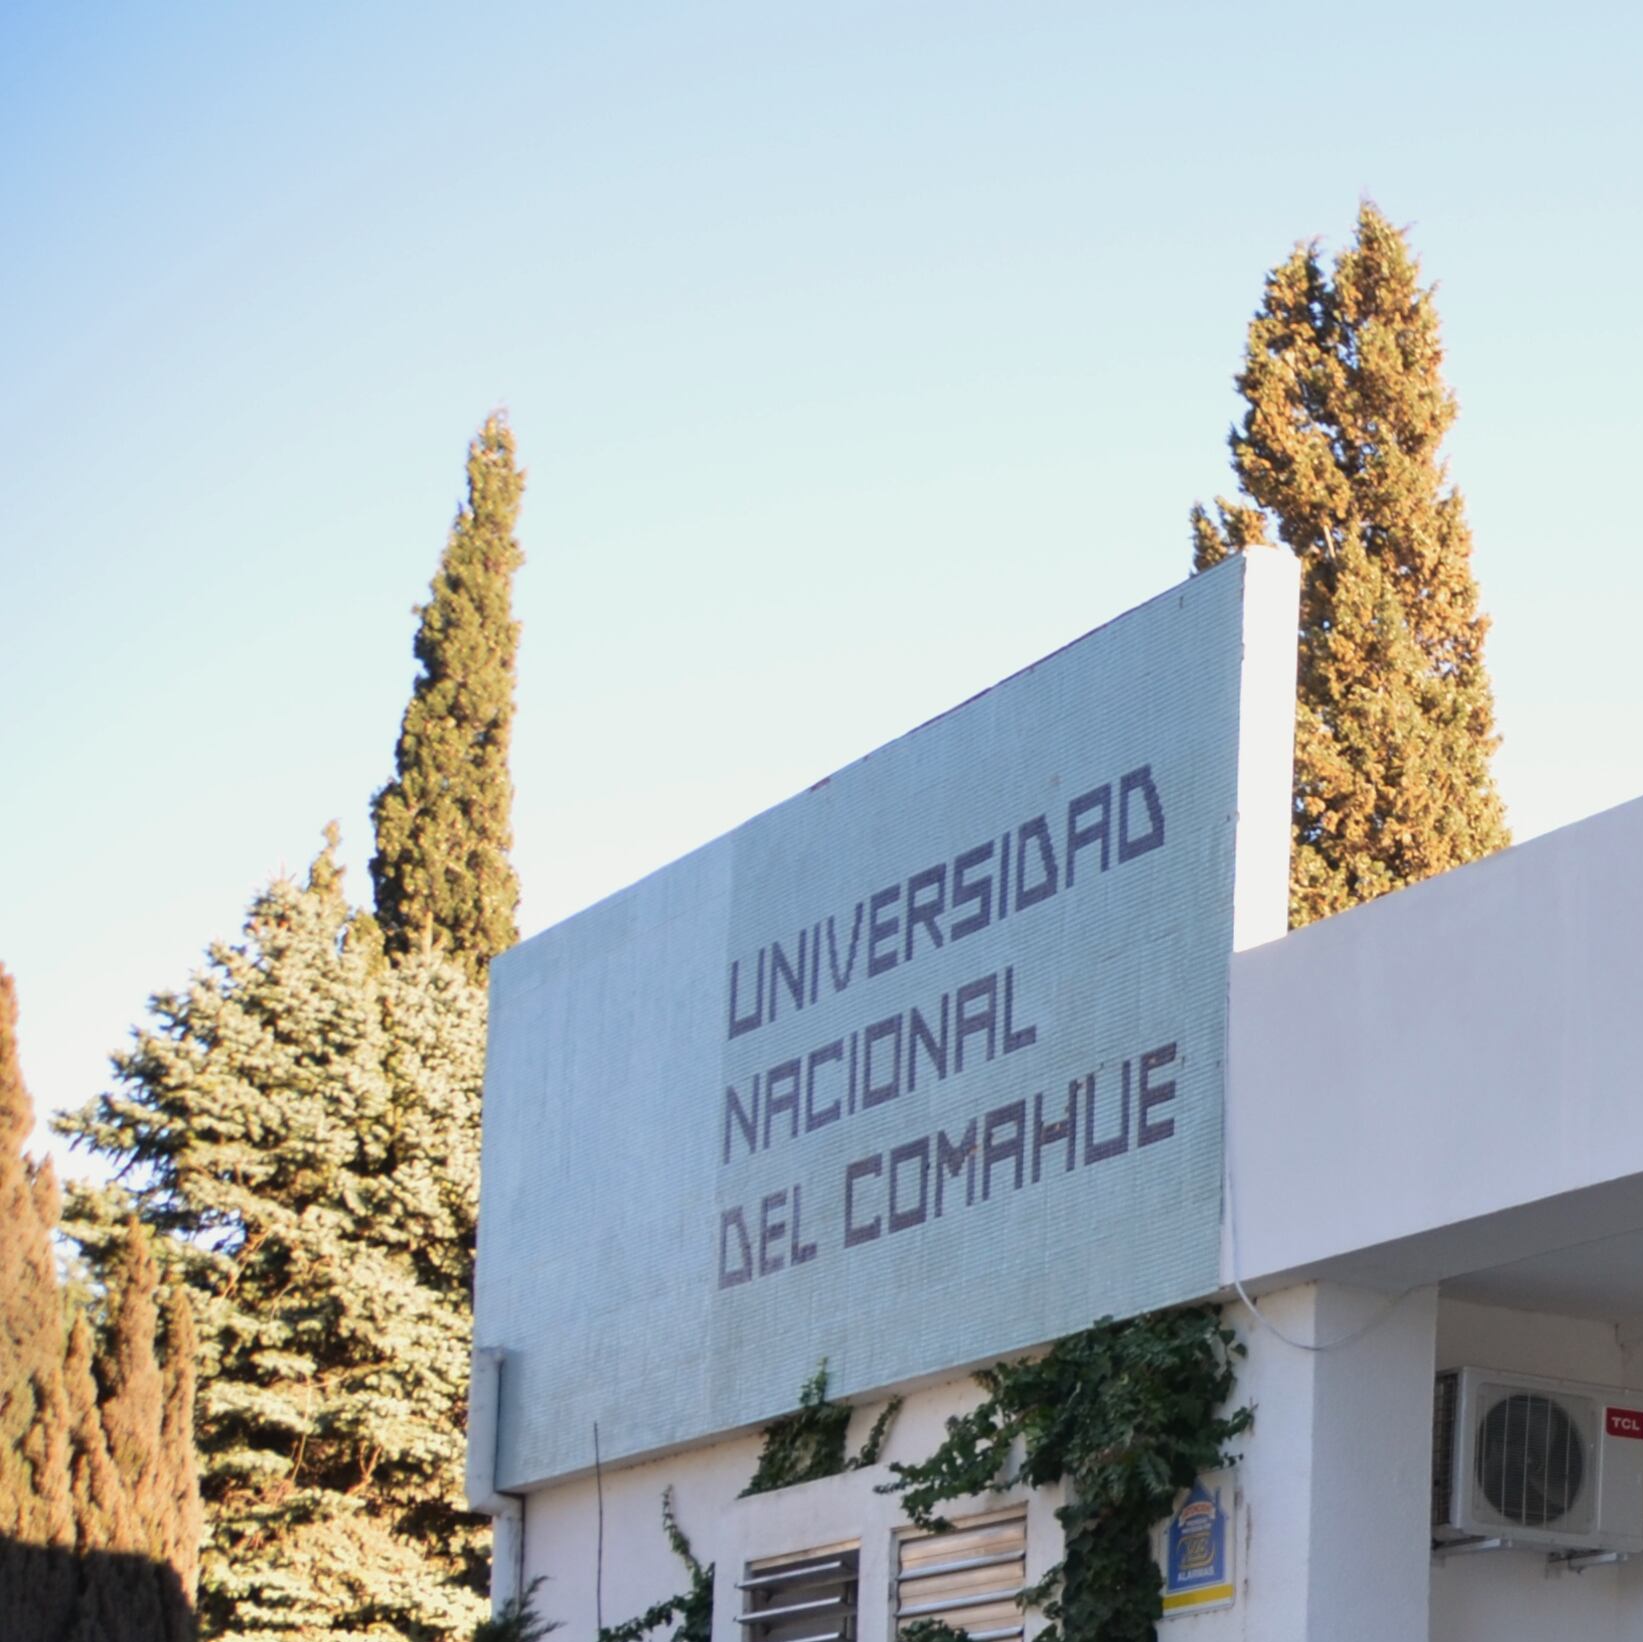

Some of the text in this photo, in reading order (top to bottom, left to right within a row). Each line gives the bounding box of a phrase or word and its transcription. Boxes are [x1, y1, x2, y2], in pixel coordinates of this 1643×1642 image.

[728, 764, 1166, 1040] UNIVERSIDAD
[718, 1041, 1177, 1291] DEL COMAHUE
[722, 965, 1037, 1165] NACIONAL
[1611, 1417, 1640, 1431] TCL
